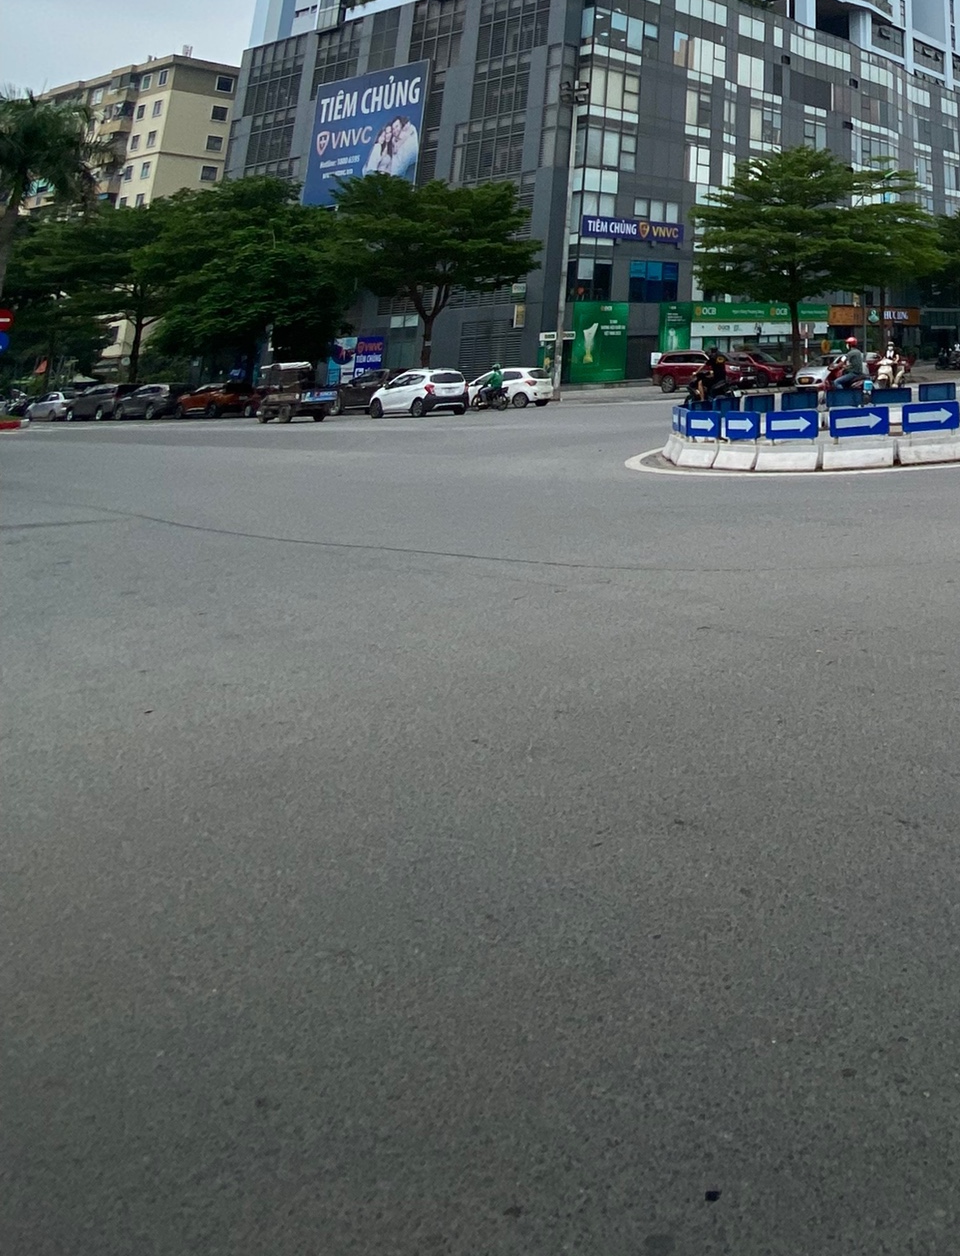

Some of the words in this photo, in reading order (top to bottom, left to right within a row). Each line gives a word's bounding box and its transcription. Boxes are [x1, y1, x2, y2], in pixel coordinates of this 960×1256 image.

[320, 90, 358, 124] TIÊM
[361, 75, 421, 114] CHỦNG
[331, 125, 373, 150] VNVC
[587, 218, 608, 233] TIÊM
[609, 220, 637, 235] CHỦNG
[652, 226, 679, 238] VNVC
[702, 307, 717, 315] OCB
[775, 307, 788, 315] OCB
